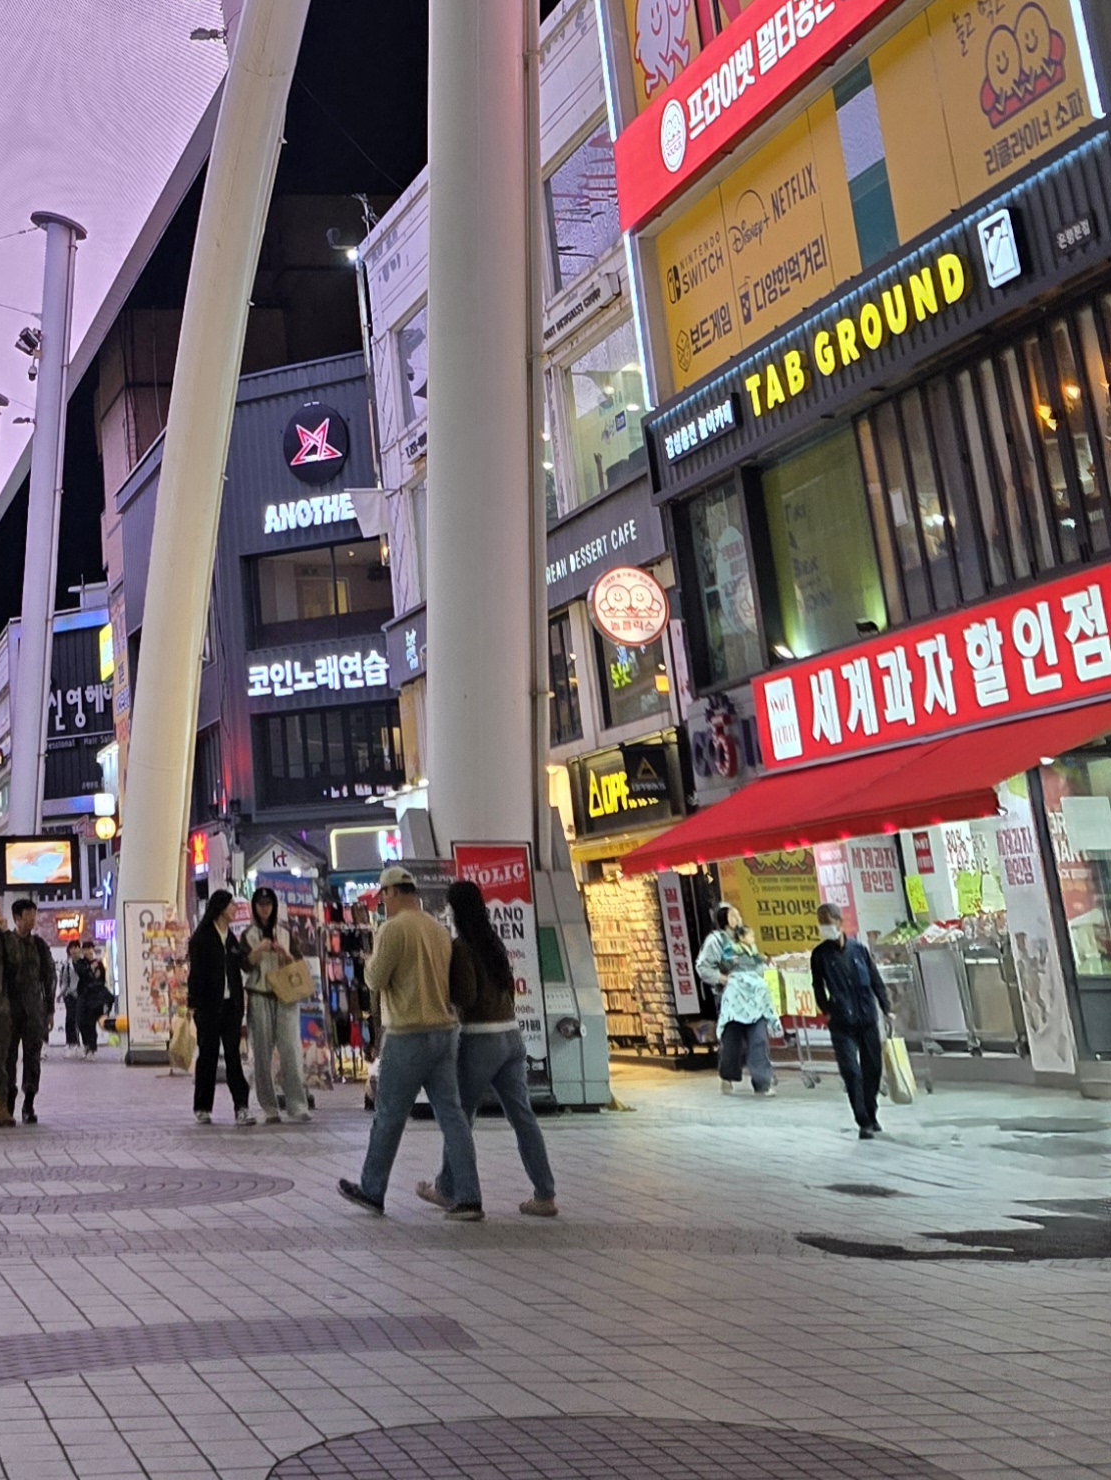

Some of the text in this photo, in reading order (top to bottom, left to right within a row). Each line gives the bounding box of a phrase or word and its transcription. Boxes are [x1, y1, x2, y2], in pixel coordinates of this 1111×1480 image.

[686, 38, 756, 141] 프라이빗
[983, 87, 1085, 177] 리클라이너 소파
[770, 162, 818, 224] NETFLIX
[678, 231, 721, 271] NINTENDO
[682, 246, 726, 295] SWITCH
[753, 234, 829, 313] 다양한먹거리
[690, 302, 733, 357] 보드게임
[745, 252, 966, 418] TAB GROUND
[569, 535, 609, 574] DESSERT
[610, 519, 638, 551] CAFE
[247, 649, 390, 697] 코인노래연습
[807, 582, 1111, 747] 세계과자 할인점
[272, 850, 288, 868] kt
[850, 847, 898, 870] 세계과자
[860, 871, 895, 894] 할인점
[756, 899, 817, 916] 프라이빗
[760, 924, 821, 942] 멀티공간
